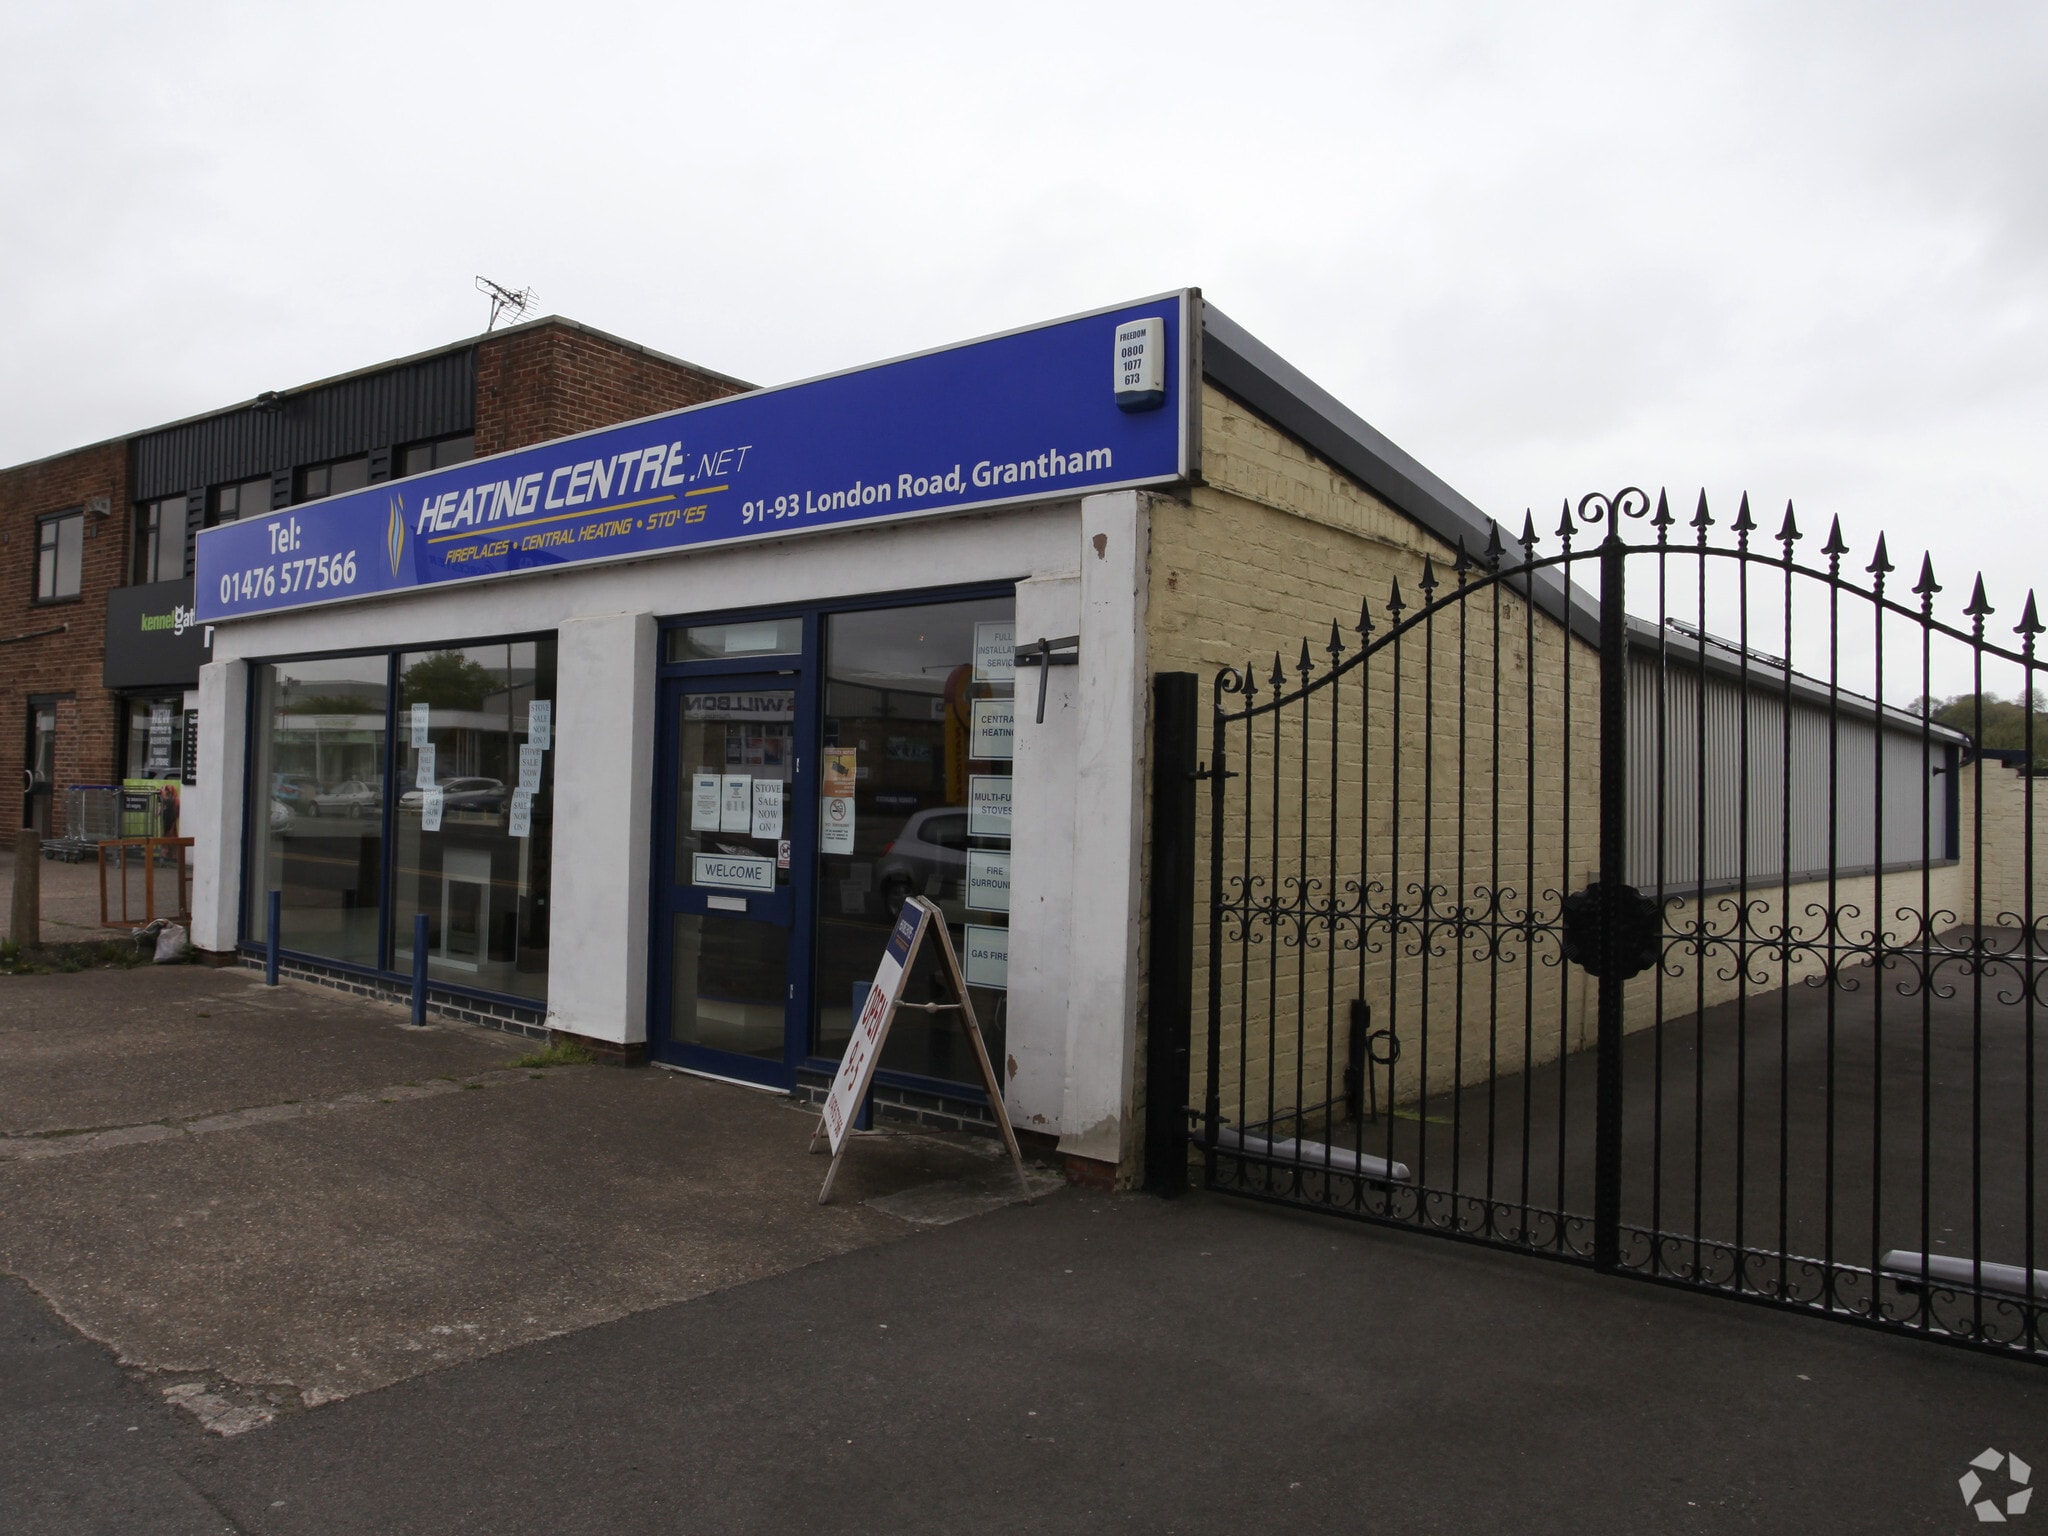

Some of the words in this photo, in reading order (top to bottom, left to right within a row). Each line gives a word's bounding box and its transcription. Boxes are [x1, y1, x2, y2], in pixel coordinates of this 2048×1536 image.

[1120, 329, 1146, 341] FREEDOM
[1121, 344, 1144, 358] 0800
[1123, 359, 1142, 371] 1077
[1124, 373, 1140, 385] 673
[741, 493, 800, 524] 91-93
[806, 481, 891, 514] London
[898, 465, 967, 499] Road,
[972, 447, 1112, 488] Grantham
[416, 472, 543, 535] HEATING
[268, 517, 301, 555] Tel:
[445, 540, 509, 564] FIREPLACES
[521, 528, 575, 551] CENTRAL
[577, 518, 633, 542] HEATING
[220, 566, 275, 605] 01476
[280, 550, 356, 594] 577566
[994, 632, 1012, 641] FULL
[987, 658, 1015, 667] SERVIC
[521, 748, 540, 756] STOVE
[755, 783, 782, 794] STOVE
[758, 797, 778, 806] SALE
[758, 810, 778, 819] NOW
[705, 864, 762, 880] WELCOME
[986, 866, 1004, 876] FIRE
[971, 950, 988, 959] GAS
[862, 984, 888, 1045] OPEN
